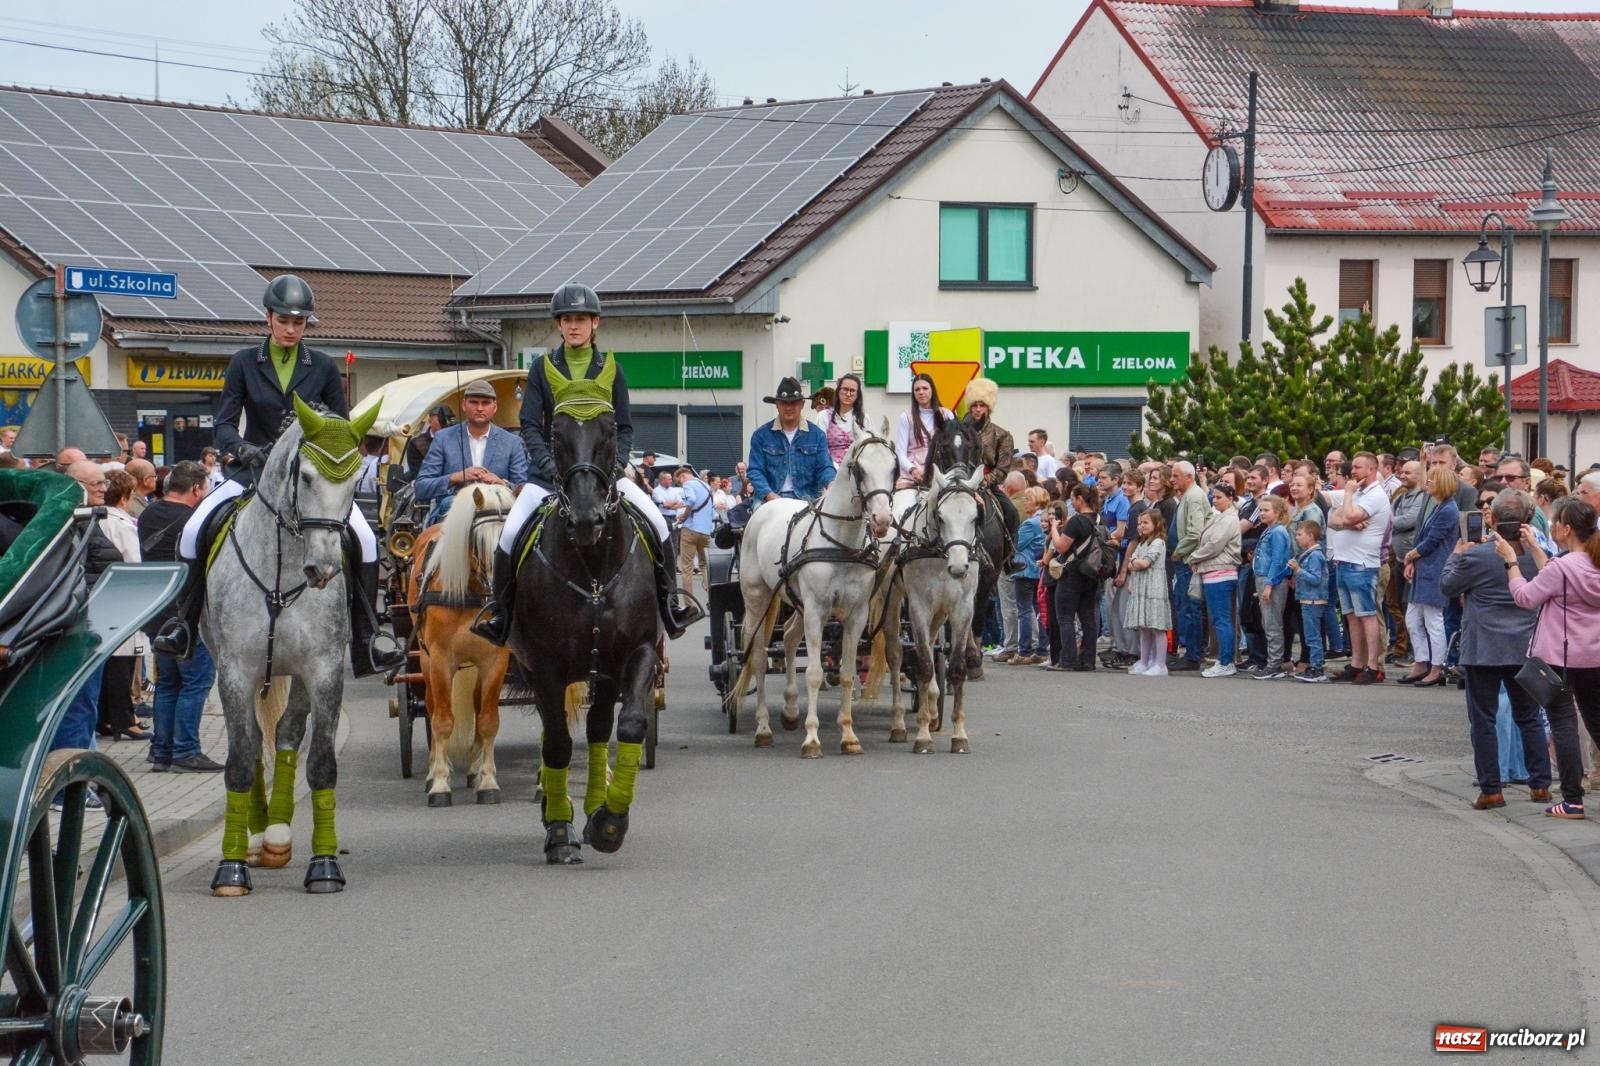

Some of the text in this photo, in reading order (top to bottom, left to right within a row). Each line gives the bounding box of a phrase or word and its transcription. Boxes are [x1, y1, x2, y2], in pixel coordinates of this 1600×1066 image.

[983, 346, 1177, 370] PTEKA ZIELONA
[681, 365, 729, 379] ZIELONA
